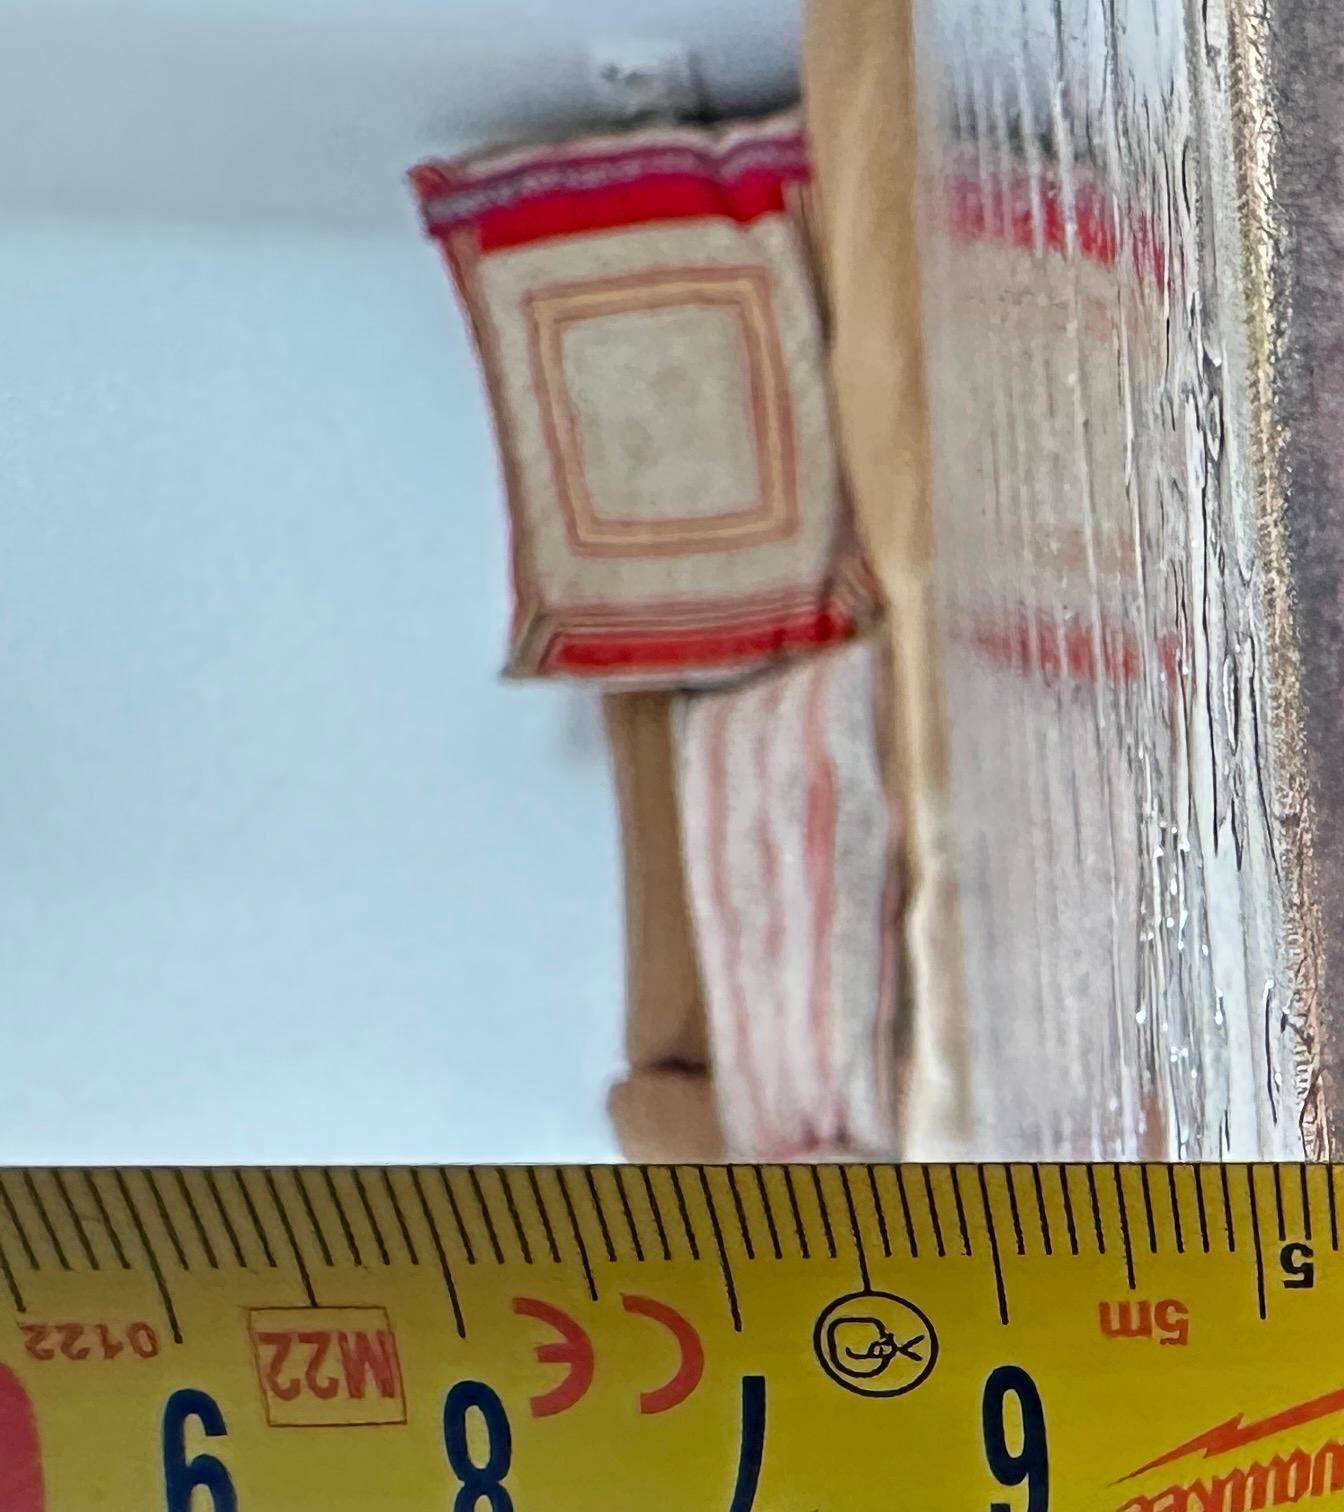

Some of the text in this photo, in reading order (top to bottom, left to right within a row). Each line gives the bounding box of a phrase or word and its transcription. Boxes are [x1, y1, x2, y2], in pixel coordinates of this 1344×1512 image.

[1279, 1242, 1315, 1288] 5
[22, 1322, 159, 1360] 0122
[1098, 1300, 1190, 1345] 5m
[258, 1331, 396, 1401] M22
[513, 1293, 704, 1417] CE
